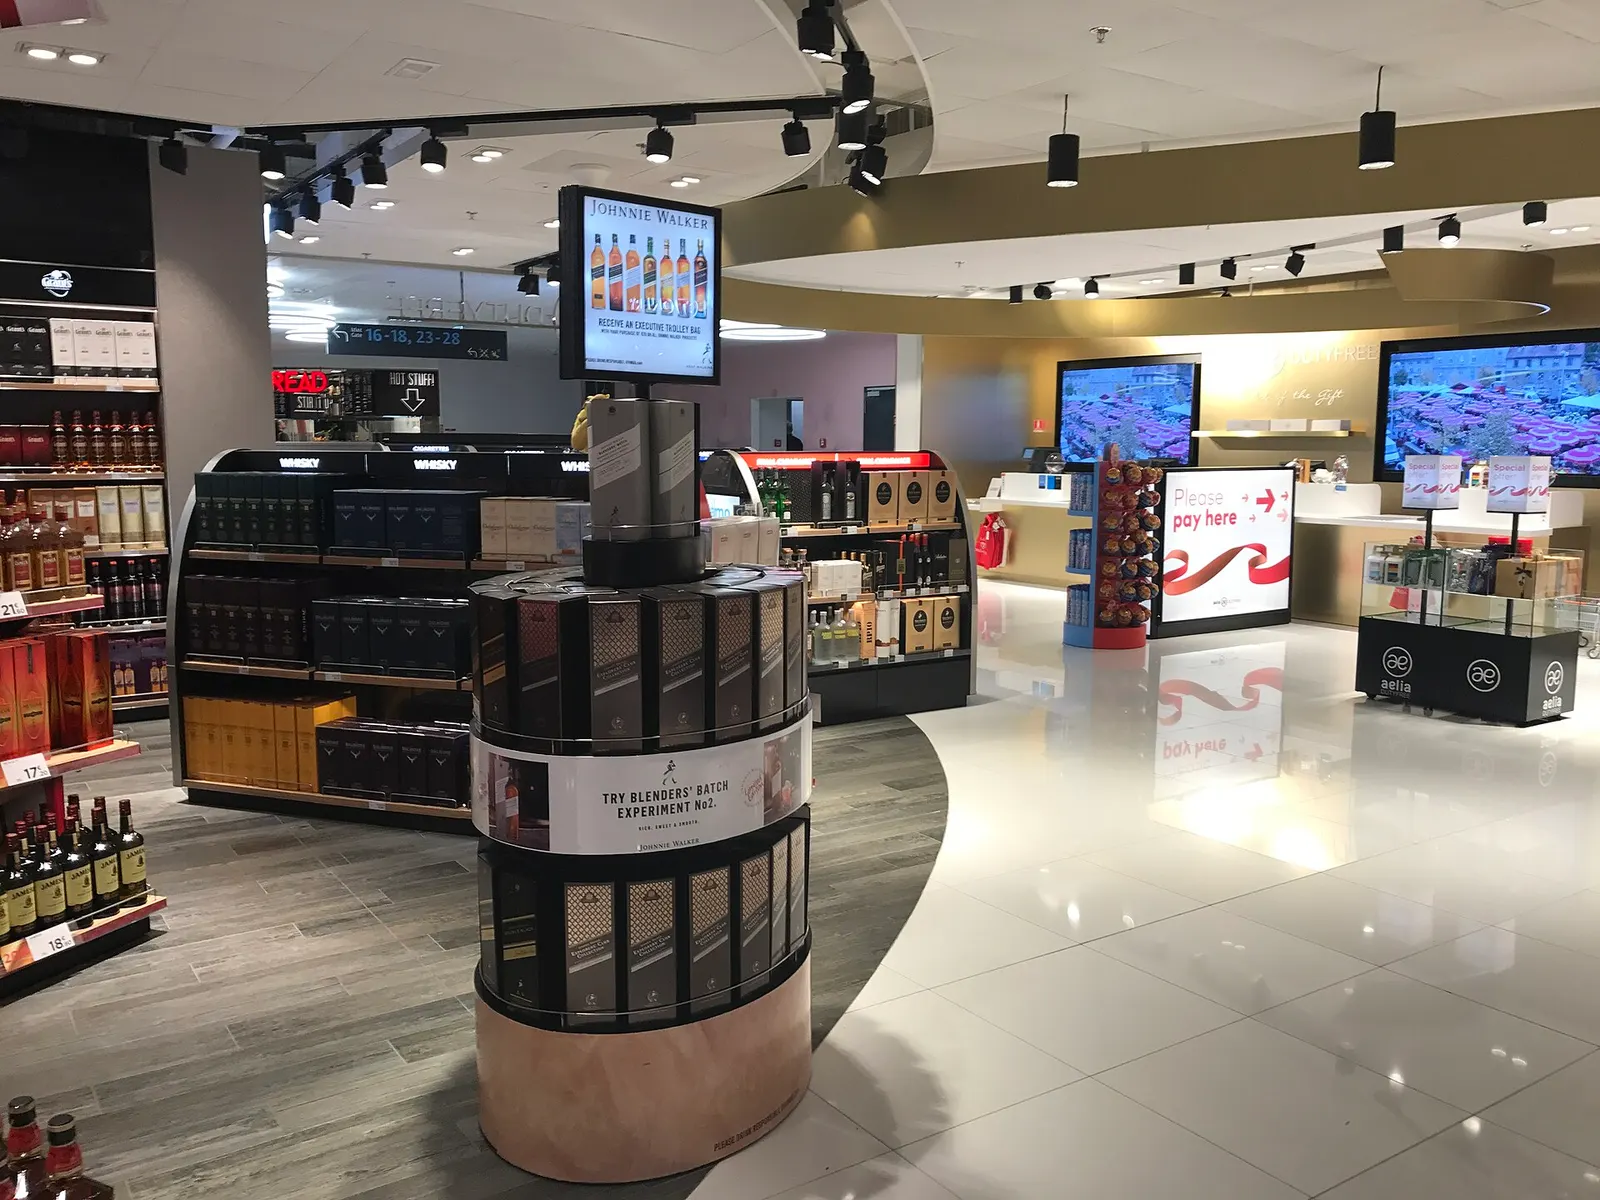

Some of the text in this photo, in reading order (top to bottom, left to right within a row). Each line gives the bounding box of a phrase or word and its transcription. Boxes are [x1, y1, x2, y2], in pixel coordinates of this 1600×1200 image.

[590, 199, 709, 230] JOHNNIE WALKER
[598, 317, 624, 329] RECEIVE
[625, 319, 634, 329] AN
[635, 320, 664, 332] EXECUTIVE
[665, 323, 689, 334] TROLLEY
[690, 326, 701, 335] BAG
[365, 327, 461, 345] 16-18, 23-28
[389, 372, 435, 387] HOT STUFF!
[297, 395, 313, 409] STIR
[1292, 388, 1312, 400] the
[1315, 388, 1345, 406] Gift
[279, 457, 320, 469] WHISKY
[413, 459, 457, 471] WHISKY
[561, 460, 590, 473] WHIS
[1408, 462, 1436, 471] Special
[1493, 463, 1526, 472] Special
[1173, 487, 1224, 507] Please
[1172, 508, 1237, 532] pay here
[1, 603, 16, 616] 21
[1381, 678, 1412, 693] aelia
[1542, 695, 1563, 710] aelia
[23, 766, 37, 780] 17
[602, 779, 729, 805] TRY BLENDERS' BATCH
[617, 797, 717, 819] EXPERIMENT No2.
[639, 837, 700, 852] JOHNNIE WALKER
[48, 937, 64, 951] 18
[713, 1135, 735, 1152] PLEASE
